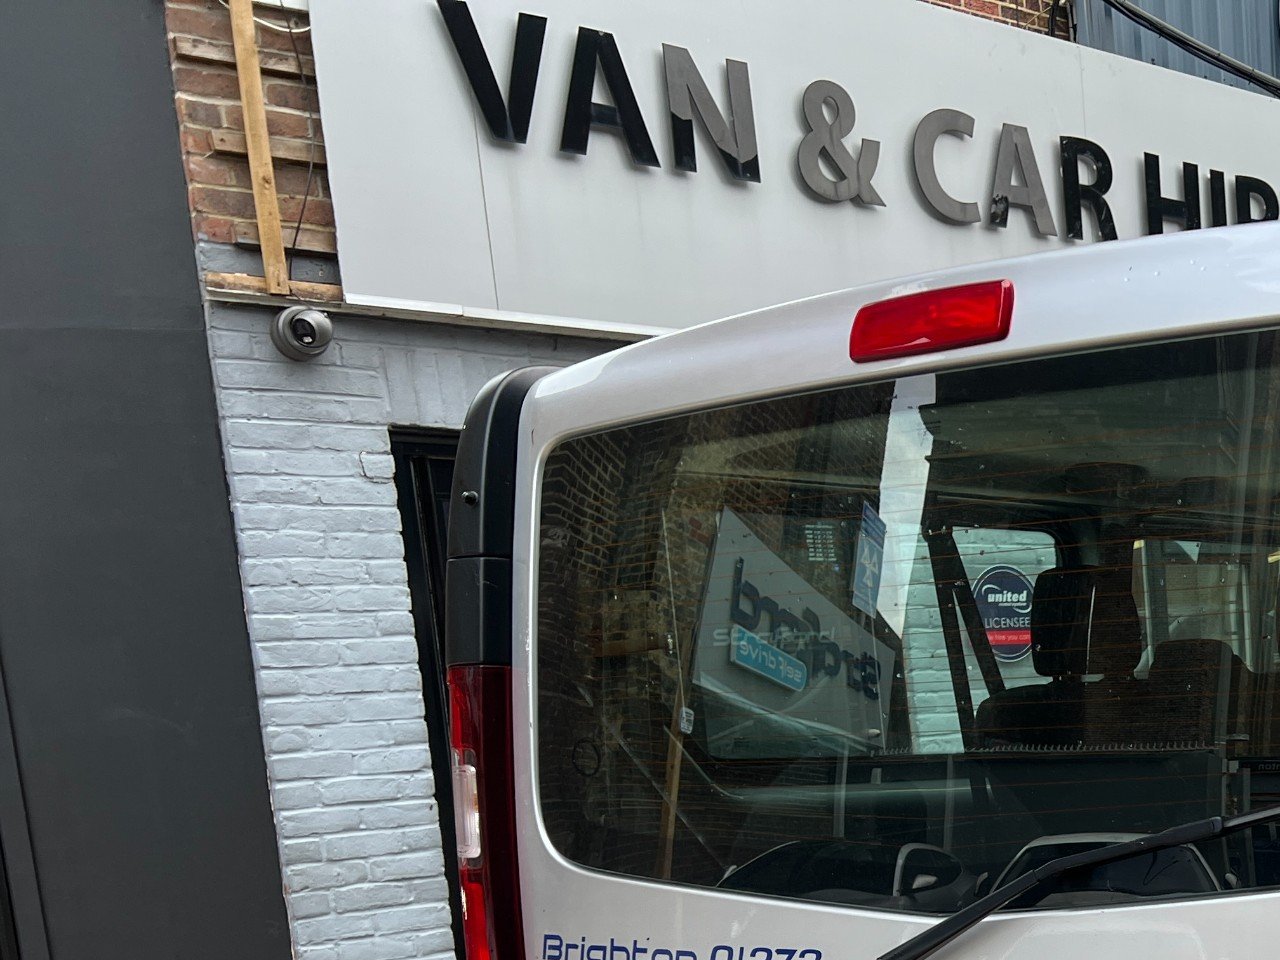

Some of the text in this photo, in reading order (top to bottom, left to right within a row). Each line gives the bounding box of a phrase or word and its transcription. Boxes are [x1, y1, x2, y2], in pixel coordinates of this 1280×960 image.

[436, 0, 762, 183] VAN
[799, 79, 888, 208] &
[912, 108, 1118, 242] CAR
[987, 590, 1027, 602] united
[984, 617, 1031, 629] LICENSEE
